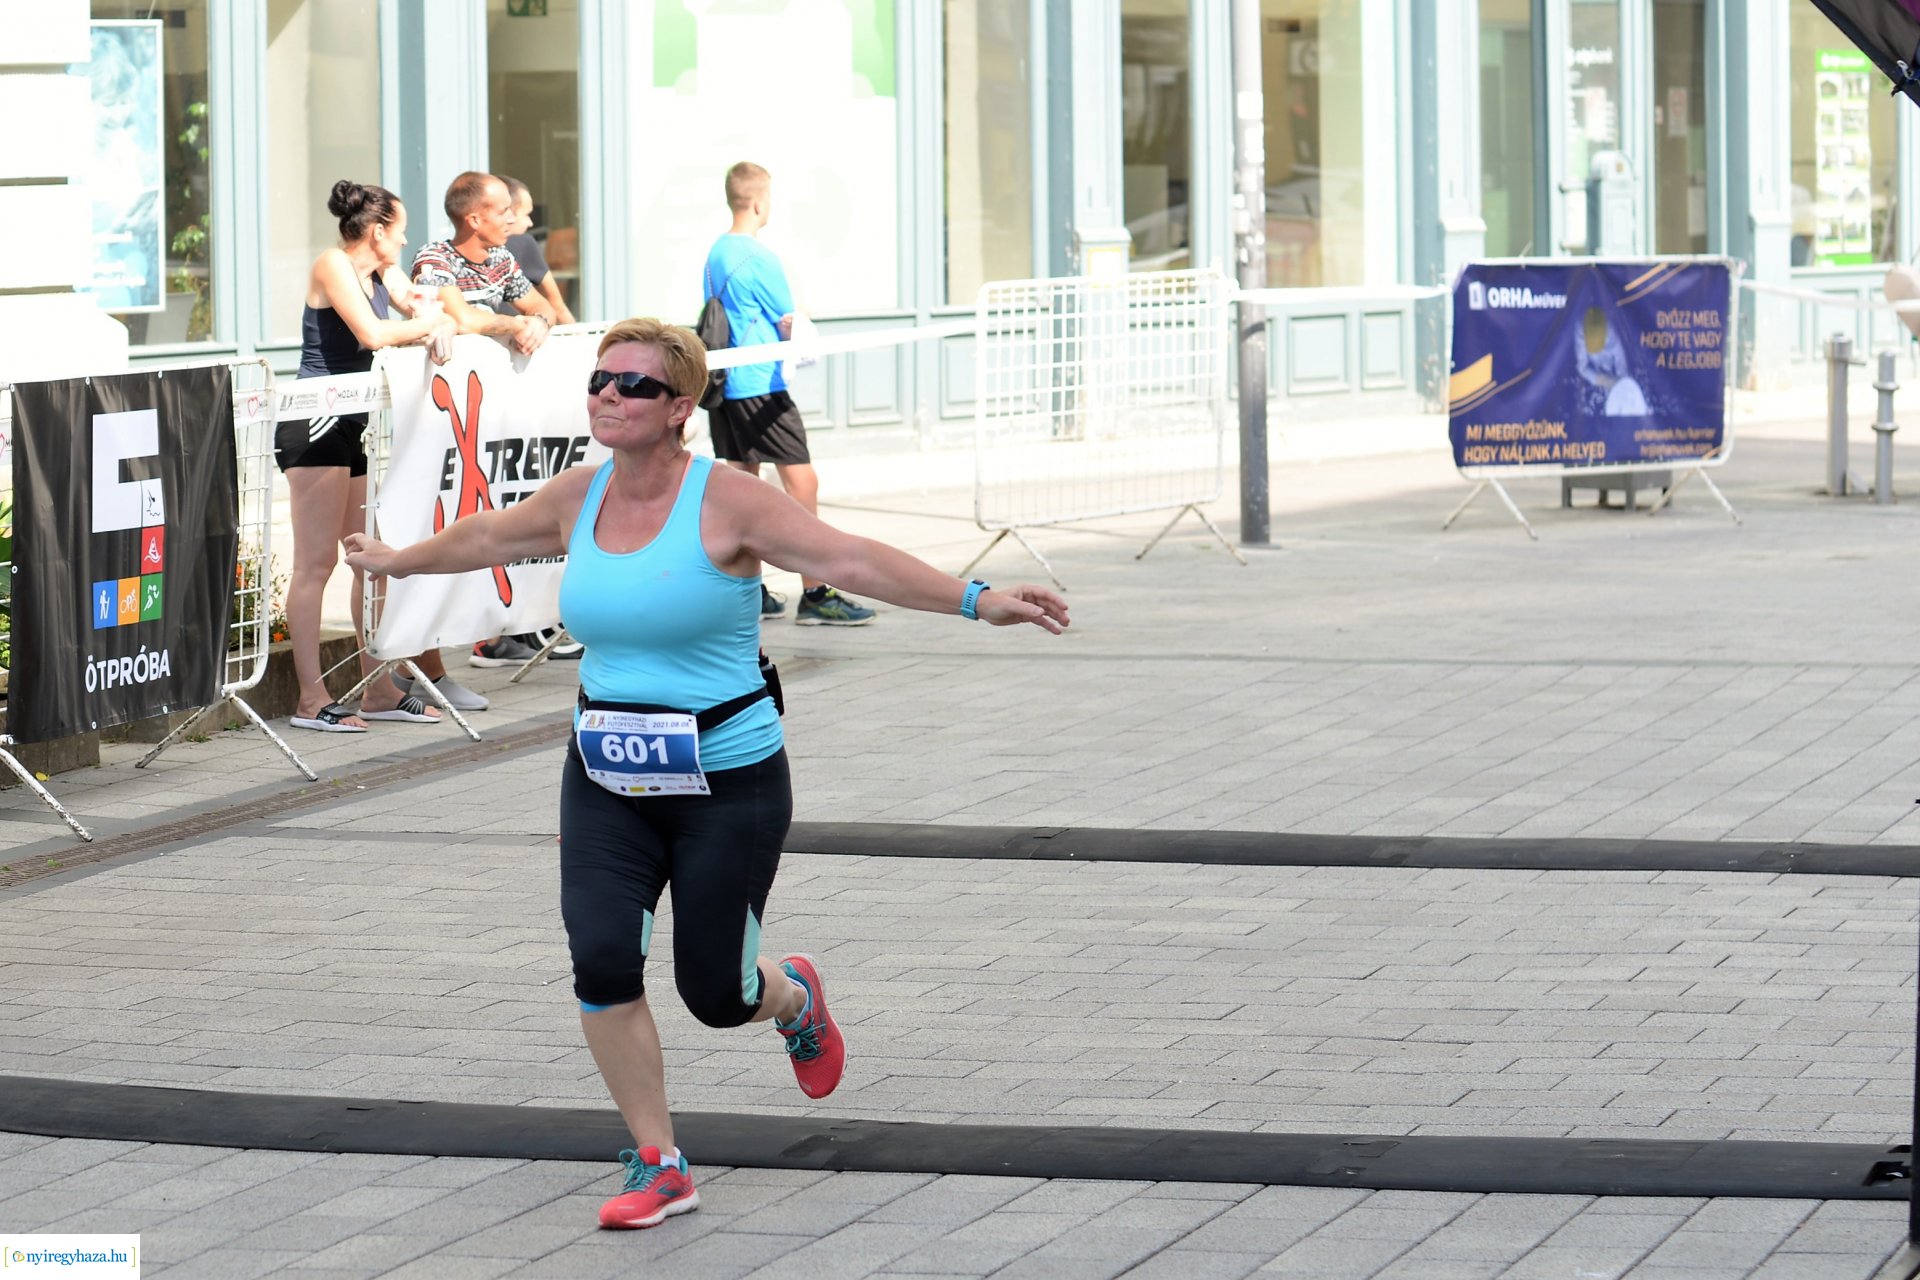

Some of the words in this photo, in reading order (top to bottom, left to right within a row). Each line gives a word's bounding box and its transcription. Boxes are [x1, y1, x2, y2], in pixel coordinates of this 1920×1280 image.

[1640, 331, 1676, 349] HOGY
[1677, 331, 1691, 349] TE
[1692, 330, 1722, 349] VAGY
[1656, 351, 1666, 369] A
[1668, 350, 1722, 369] LEGJOBB
[337, 388, 360, 399] MOZAIK
[1466, 423, 1483, 441] MI
[1463, 445, 1499, 464] HOGY
[1499, 442, 1550, 463] NÁLUNK
[1552, 443, 1562, 460] A
[1563, 441, 1606, 461] HELYED
[85, 644, 171, 693] ÖTPRÓBA
[601, 734, 669, 765] 601
